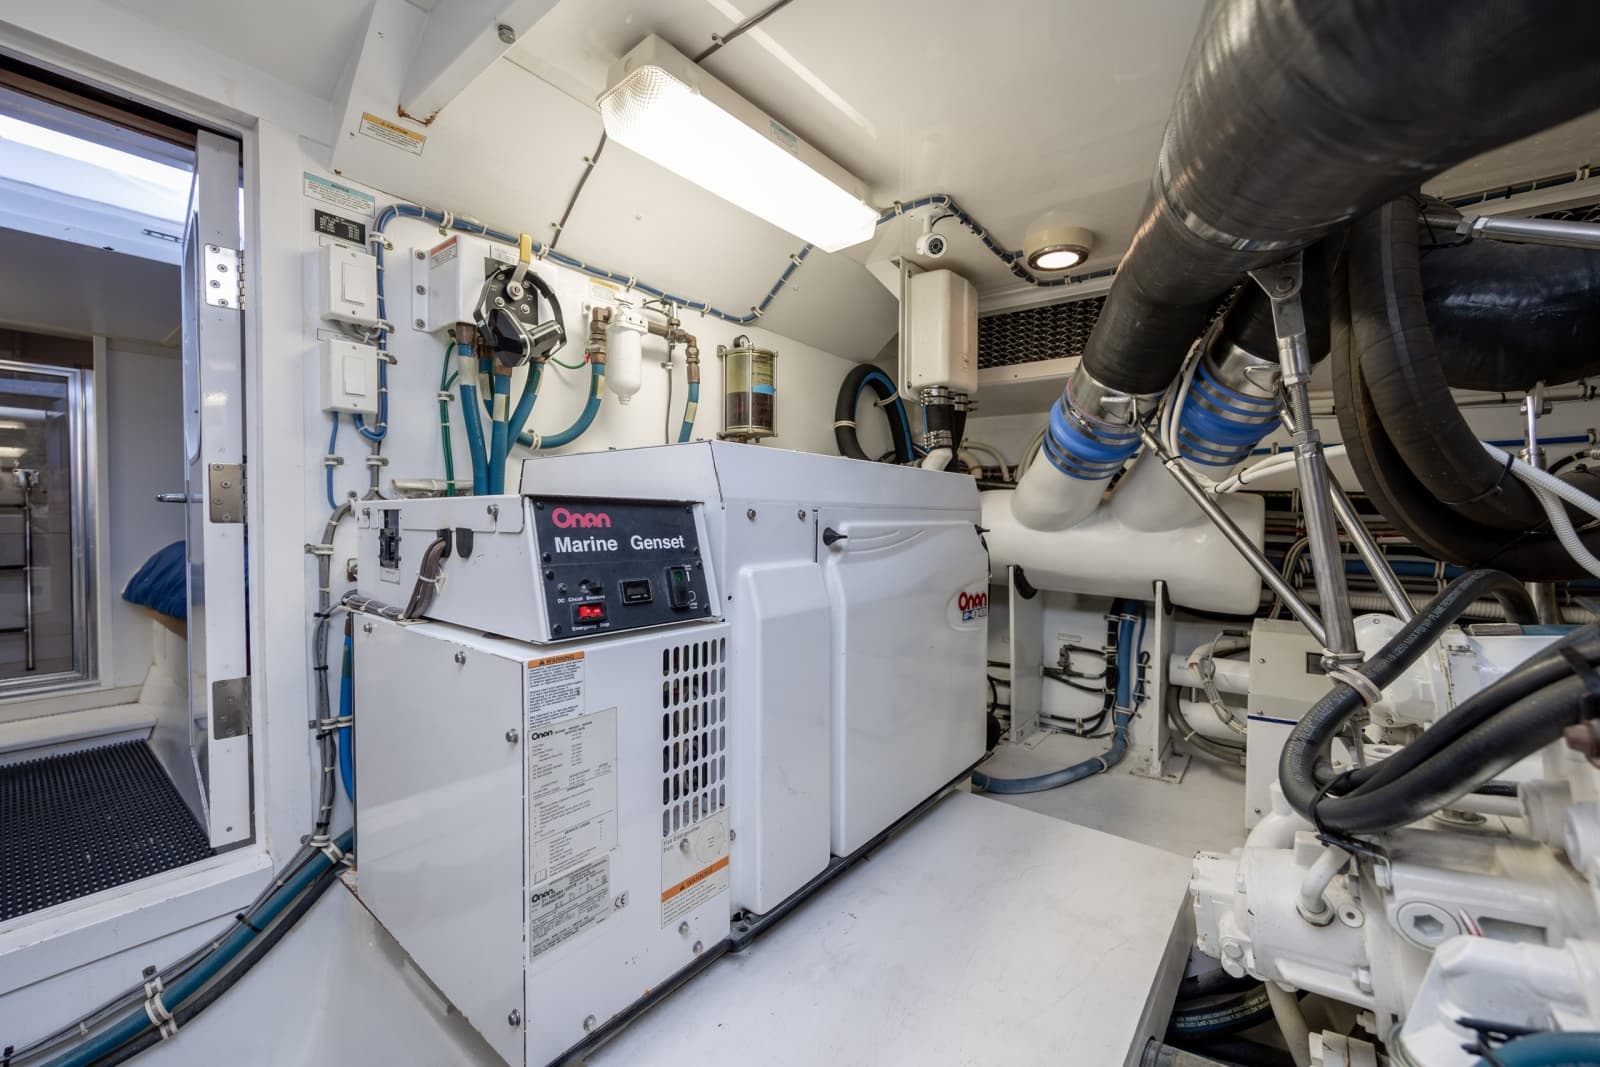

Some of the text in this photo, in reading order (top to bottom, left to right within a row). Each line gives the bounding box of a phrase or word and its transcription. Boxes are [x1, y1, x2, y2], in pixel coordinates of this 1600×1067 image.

[551, 507, 612, 528] Onan
[554, 535, 685, 553] Marine Genset
[958, 591, 987, 612] Onan
[531, 730, 554, 741] Onan
[531, 888, 555, 903] Onan
